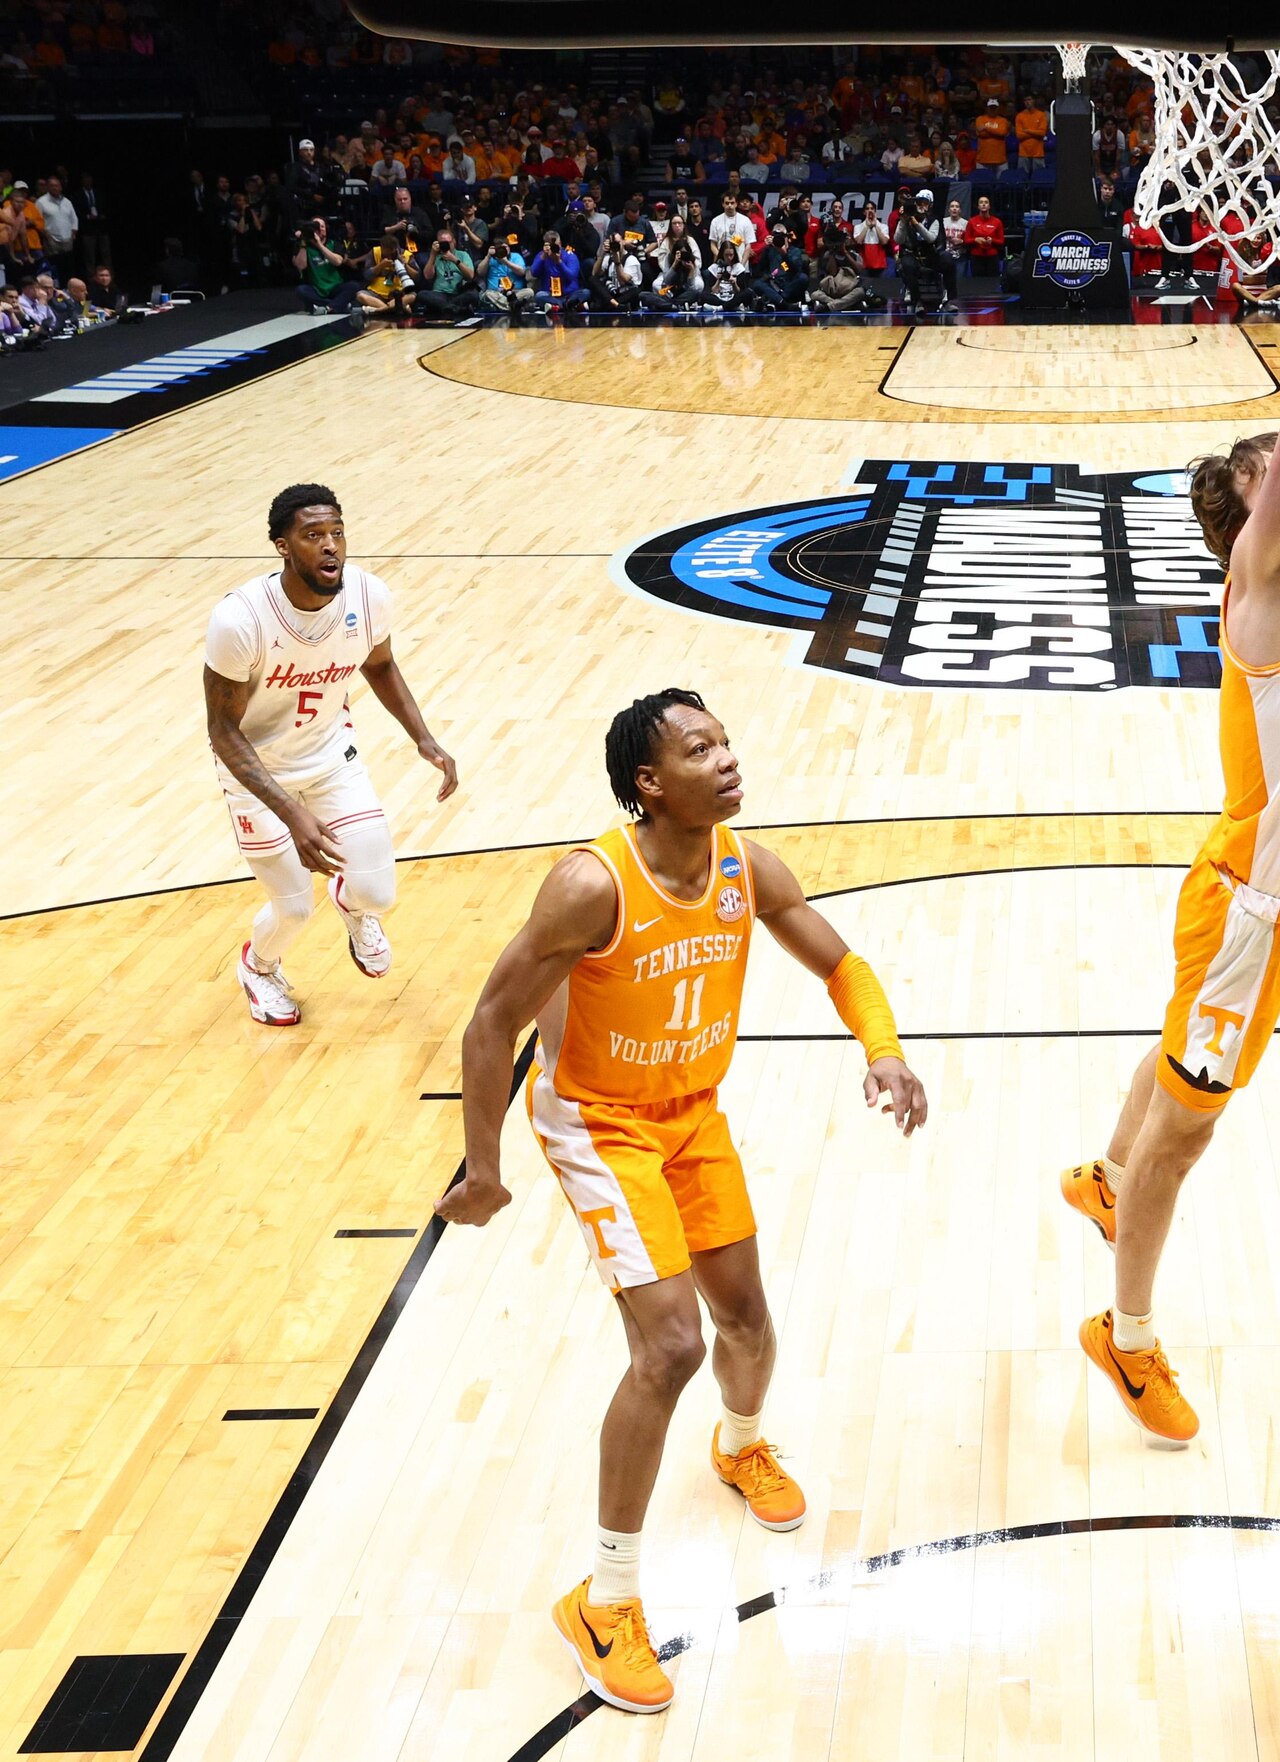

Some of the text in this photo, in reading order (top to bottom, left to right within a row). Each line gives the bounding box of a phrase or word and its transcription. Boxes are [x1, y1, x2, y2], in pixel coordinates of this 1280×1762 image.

[1051, 246, 1090, 259] MARCH
[1055, 258, 1109, 270] MADNESS
[691, 529, 786, 579] ELITE 8
[900, 507, 1116, 685] MADNESS
[265, 661, 356, 689] Houston
[295, 691, 323, 728] 5
[723, 863, 741, 874] NCAA
[720, 888, 742, 914] SEC
[633, 934, 743, 983] TENNESSEE
[664, 973, 706, 1030] 11
[609, 1010, 731, 1066] VOLUNTEERS
[1199, 1003, 1245, 1057] T
[579, 1205, 617, 1259] T
